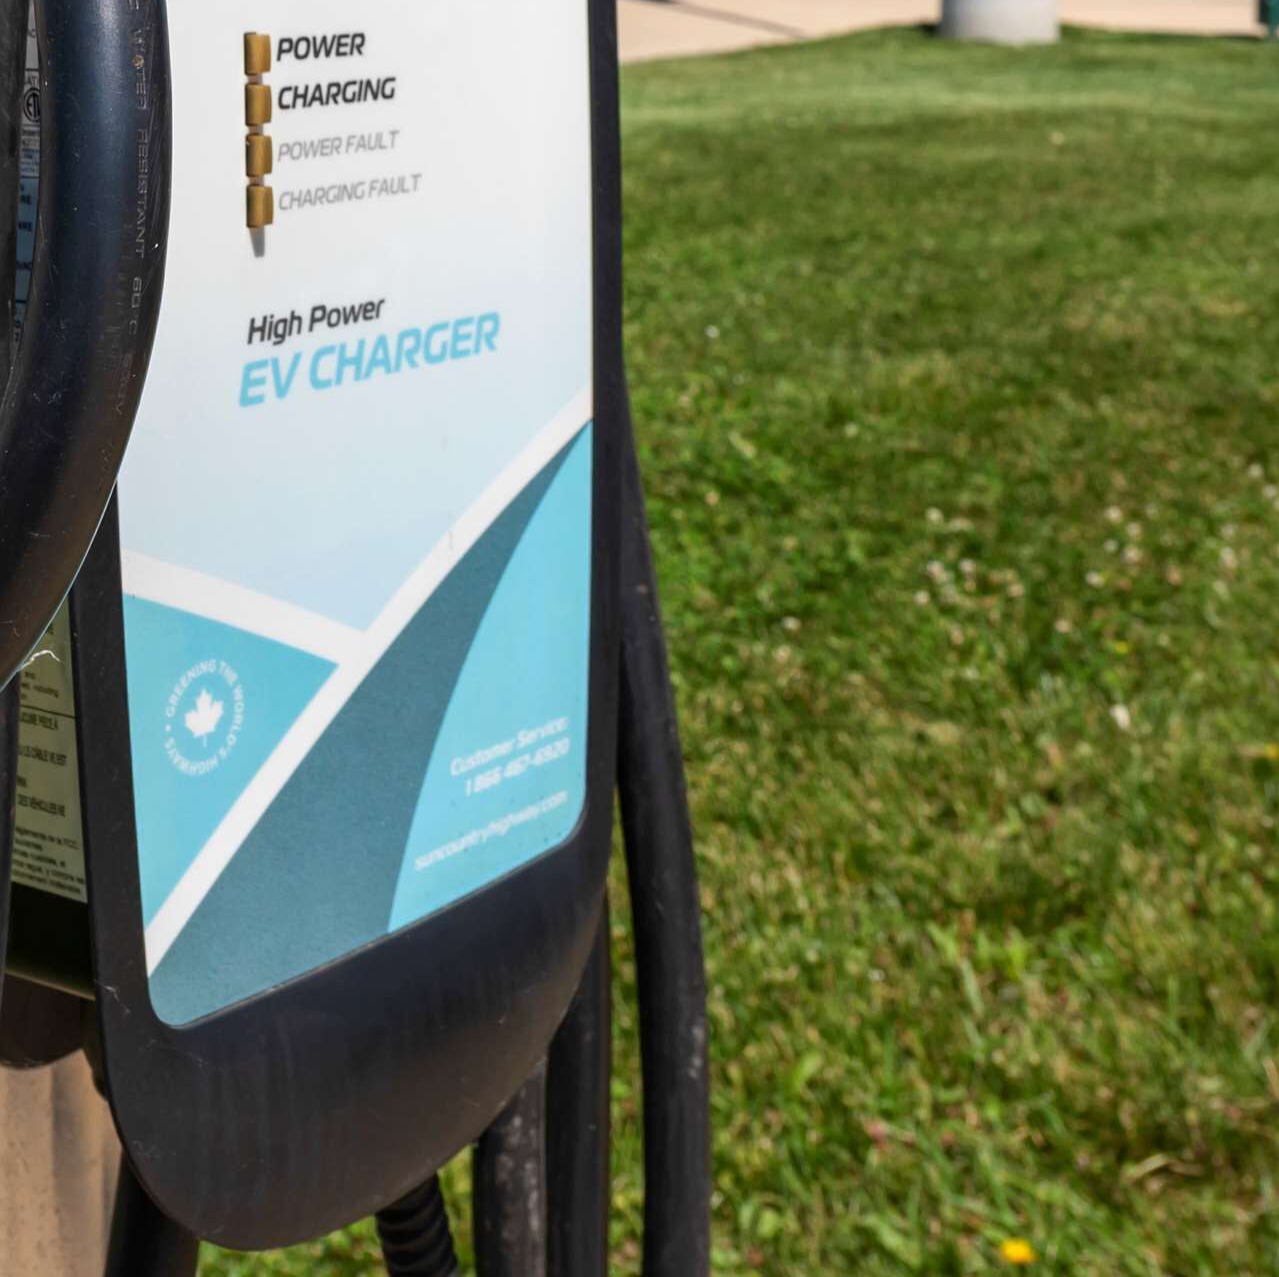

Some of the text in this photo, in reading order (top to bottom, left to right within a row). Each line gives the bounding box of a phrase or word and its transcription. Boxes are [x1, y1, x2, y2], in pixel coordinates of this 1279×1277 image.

[276, 32, 366, 62] POWER
[131, 26, 148, 110] WTER
[277, 77, 397, 110] CHARGING
[277, 129, 400, 162] POWER FAULT
[134, 127, 151, 260] RESISTANT
[278, 173, 423, 211] CHARGING FAULT
[247, 298, 386, 346] High Power
[239, 311, 501, 408] EV CHARGER
[165, 658, 217, 718] GREENING
[218, 659, 239, 687] THE
[164, 736, 219, 776] HIGHWAYS
[449, 737, 516, 776] Customer
